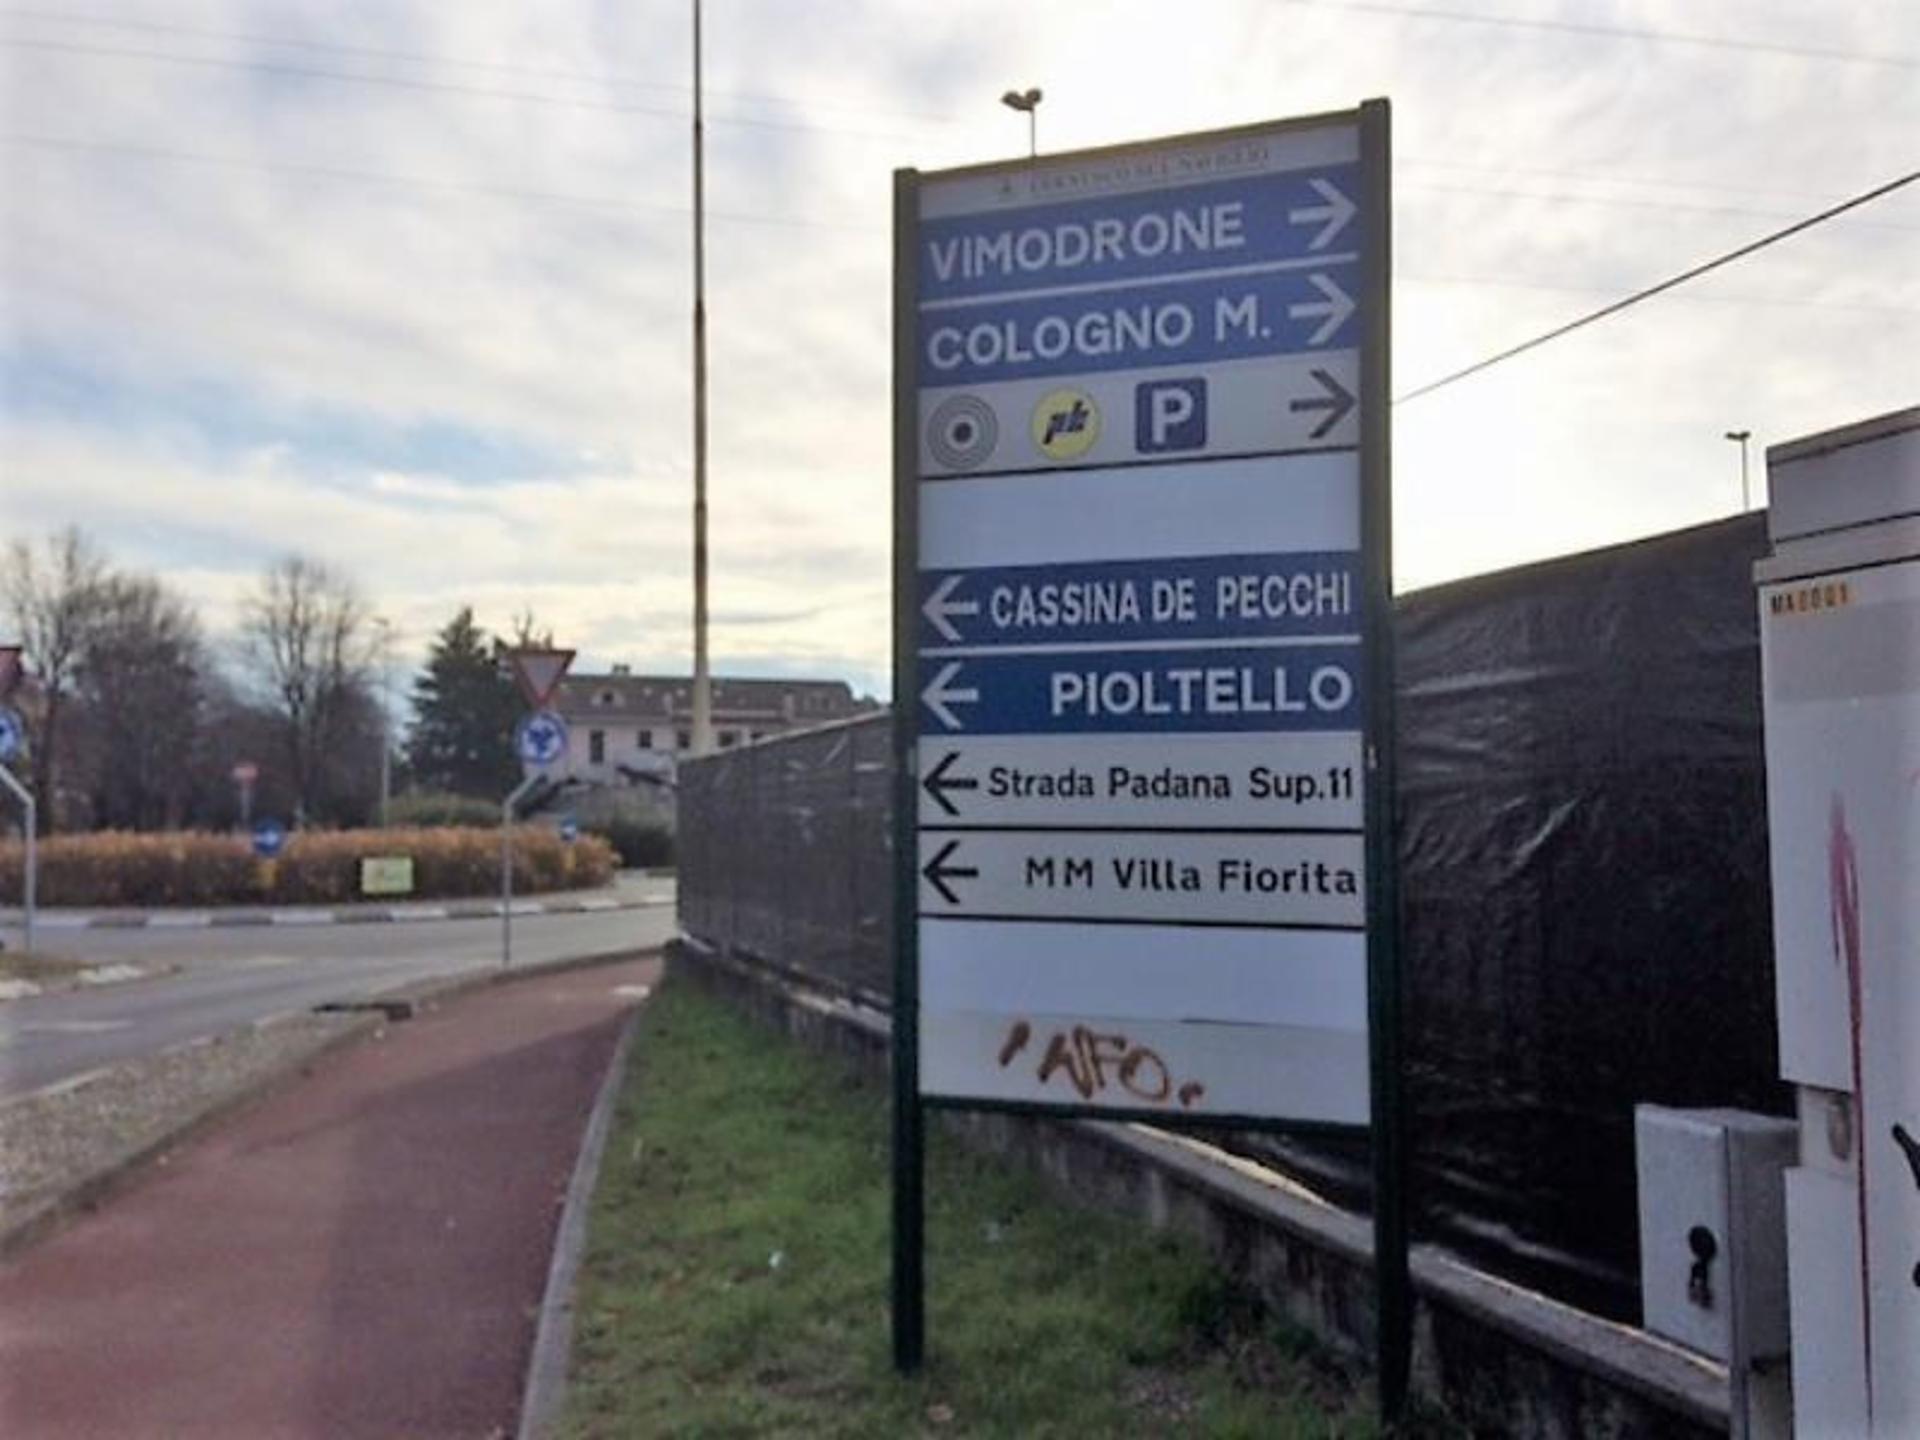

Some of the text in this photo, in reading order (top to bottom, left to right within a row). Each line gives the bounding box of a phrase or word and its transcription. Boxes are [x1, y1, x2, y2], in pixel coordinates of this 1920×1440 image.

[929, 203, 1245, 281] VIMODRONE
[927, 295, 1273, 370] COLOGNO M.
[1151, 388, 1193, 445] P
[990, 572, 1351, 627] CASSINA DE PECCHI
[1051, 666, 1353, 715] PIOLTELLO
[988, 766, 1353, 804] Strada Padana Sup.11
[1113, 858, 1201, 891] Villa
[1219, 860, 1358, 895] Fiorita
